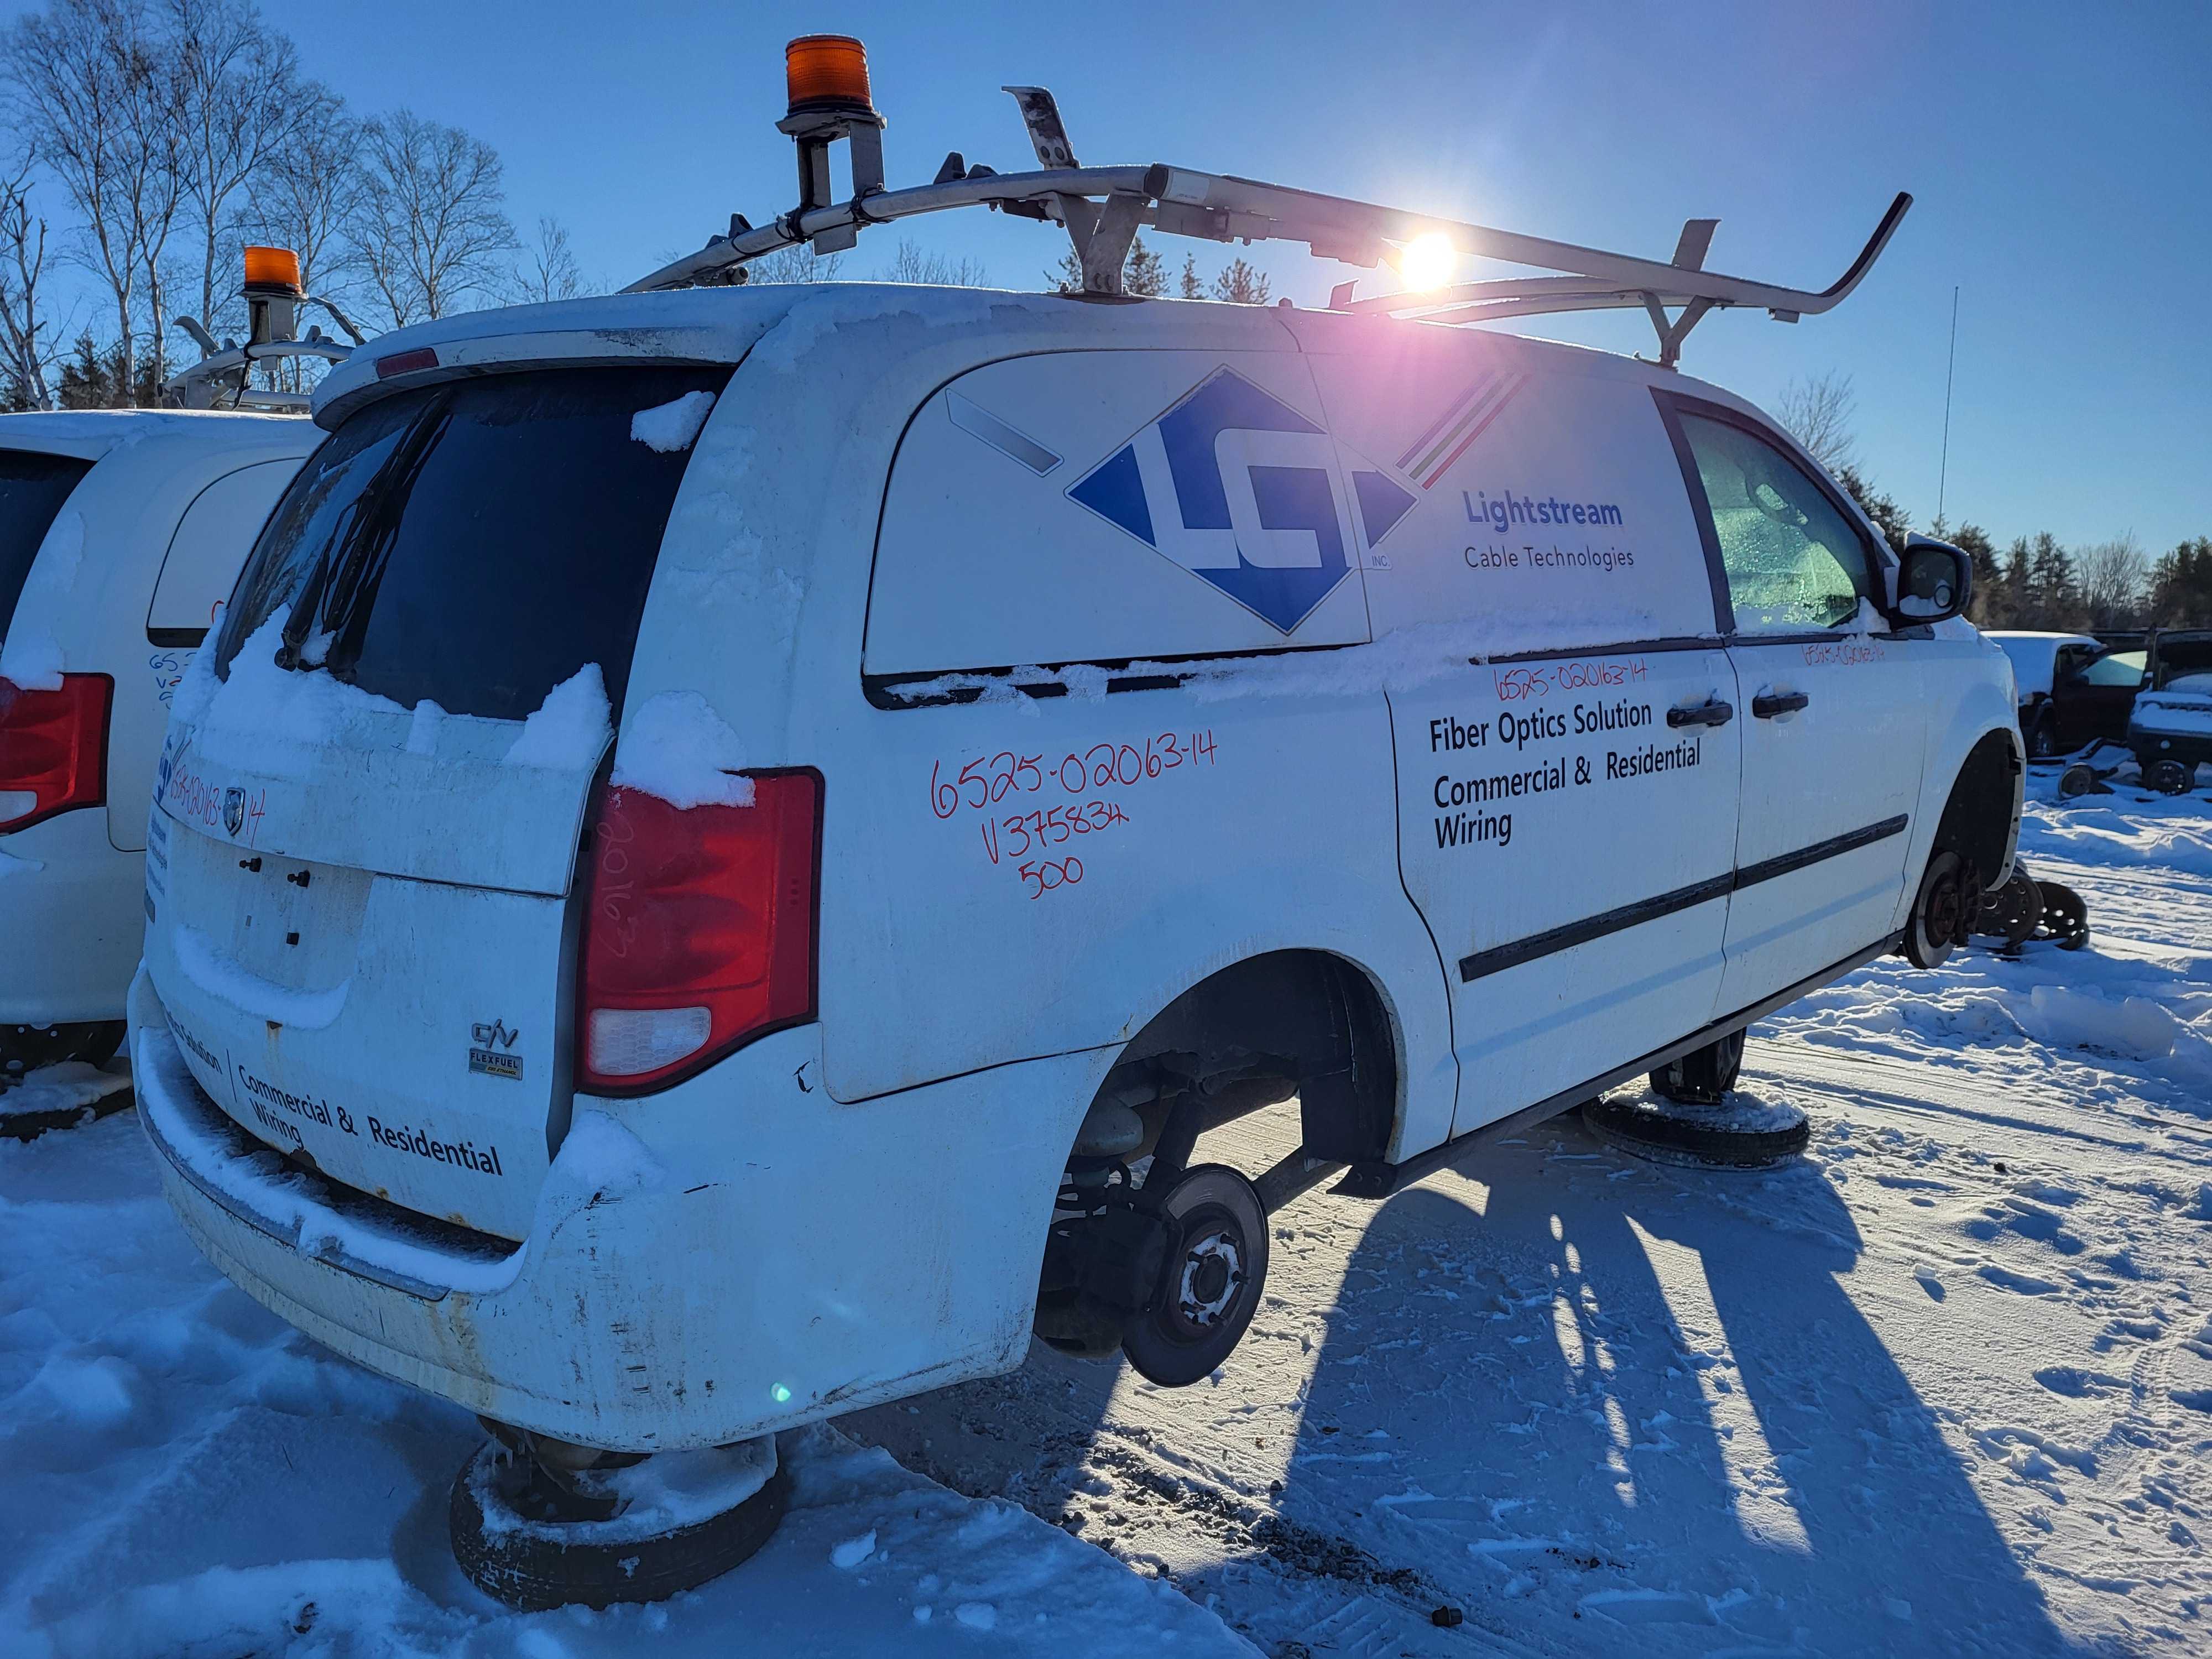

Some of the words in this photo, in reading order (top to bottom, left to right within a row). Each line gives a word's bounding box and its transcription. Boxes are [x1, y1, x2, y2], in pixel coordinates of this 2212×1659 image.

[1463, 489, 1623, 533] Lightstream
[1371, 555, 1390, 567] INC.
[1464, 544, 1518, 568] Cable
[1523, 544, 1634, 572] Technologies
[1430, 717, 1489, 752] Fiber
[1498, 707, 1566, 750] Optics
[1574, 698, 1652, 734] Solution
[1434, 757, 1566, 808] Commercial
[1574, 755, 1592, 785] &
[1606, 738, 1700, 780] Residential
[1434, 810, 1512, 849] Wiring
[1018, 857, 1084, 900] 500
[470, 1052, 518, 1068] FLEXFUEL
[238, 1064, 332, 1127] Commercial
[337, 1106, 358, 1136] &
[368, 1115, 503, 1176] Residential
[249, 1097, 304, 1151] Wiring
